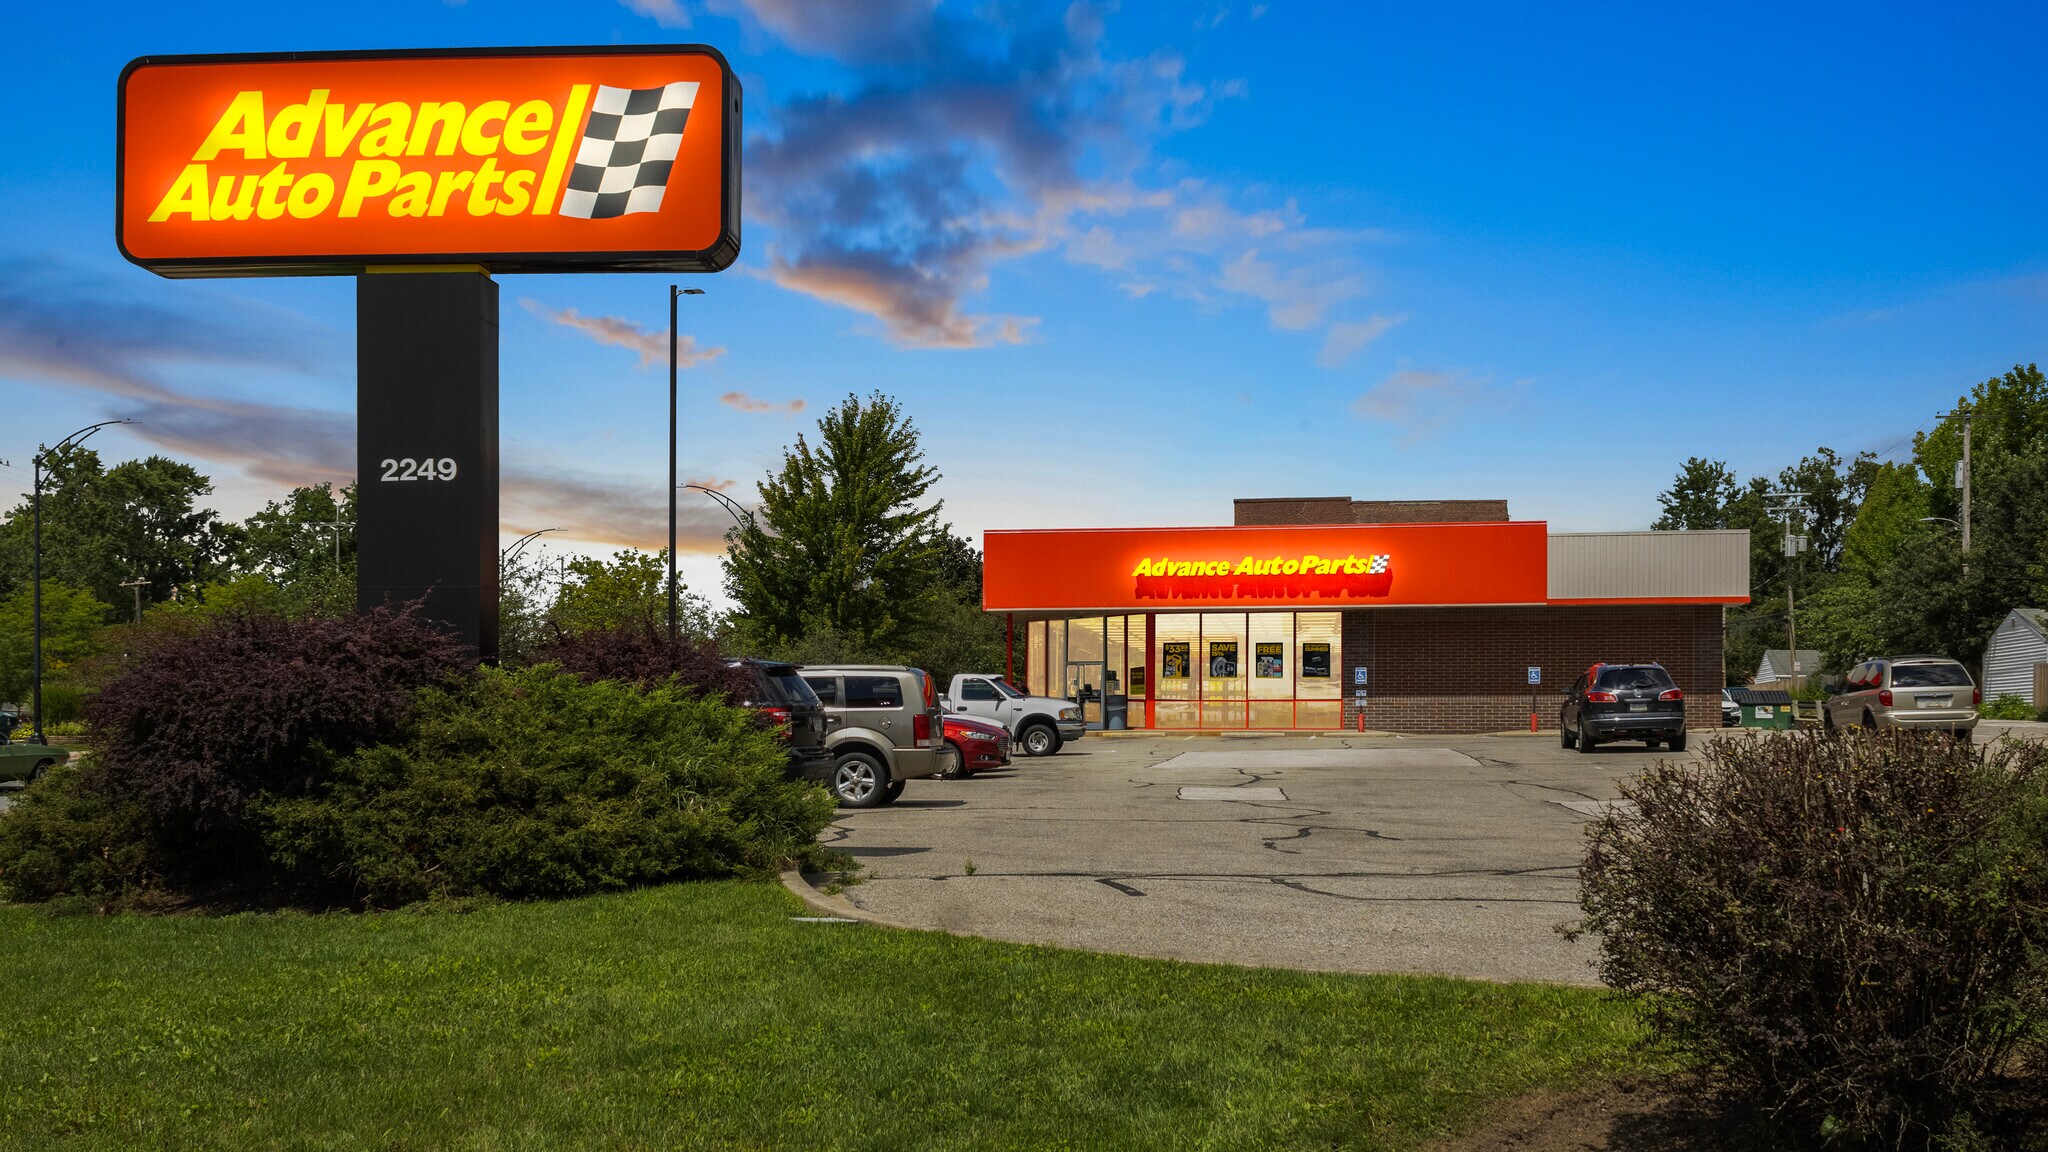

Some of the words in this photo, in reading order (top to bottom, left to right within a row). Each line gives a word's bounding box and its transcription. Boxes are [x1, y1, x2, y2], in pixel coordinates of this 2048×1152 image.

[192, 89, 554, 160] Advance
[147, 162, 335, 222] Auto
[338, 158, 535, 218] Parts
[380, 457, 458, 482] 2249
[1131, 558, 1230, 577] Advance
[1233, 555, 1300, 576] Auto
[1299, 554, 1368, 575] Parts
[1211, 643, 1236, 652] SAVE
[1257, 644, 1282, 654] FREE
